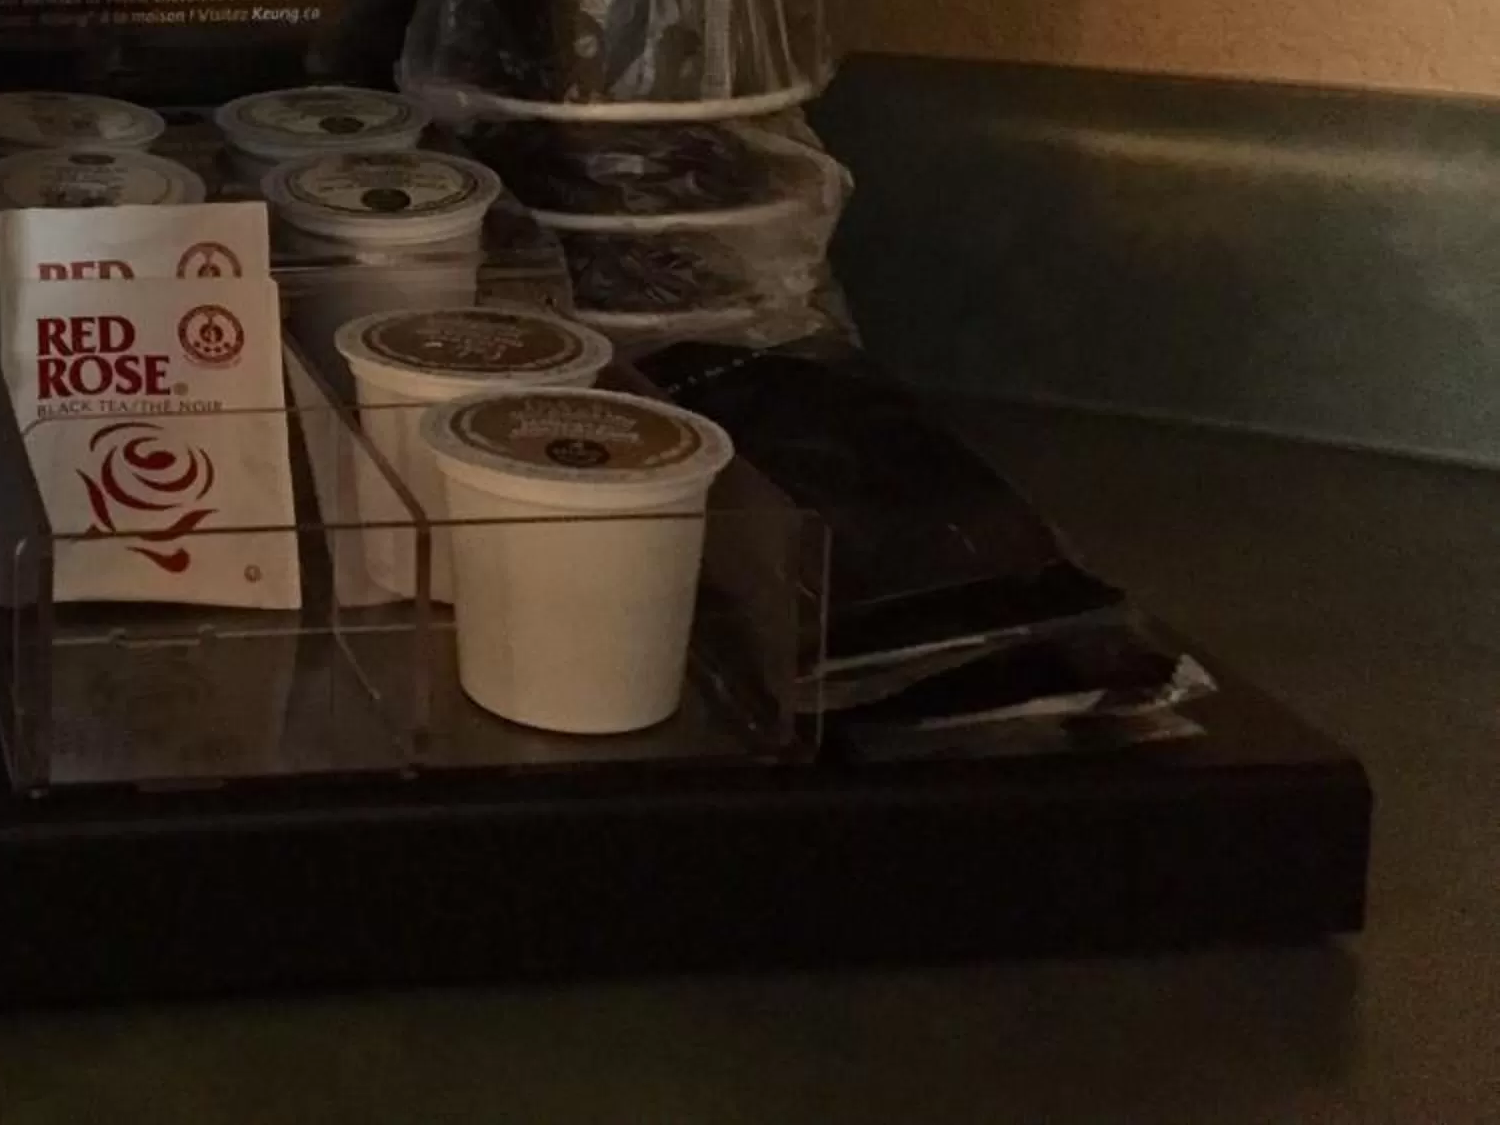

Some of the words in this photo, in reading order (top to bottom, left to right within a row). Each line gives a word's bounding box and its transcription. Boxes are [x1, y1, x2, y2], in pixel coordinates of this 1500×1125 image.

[36, 315, 136, 357] RED
[36, 354, 172, 401] ROSE
[36, 401, 92, 419] BLACK
